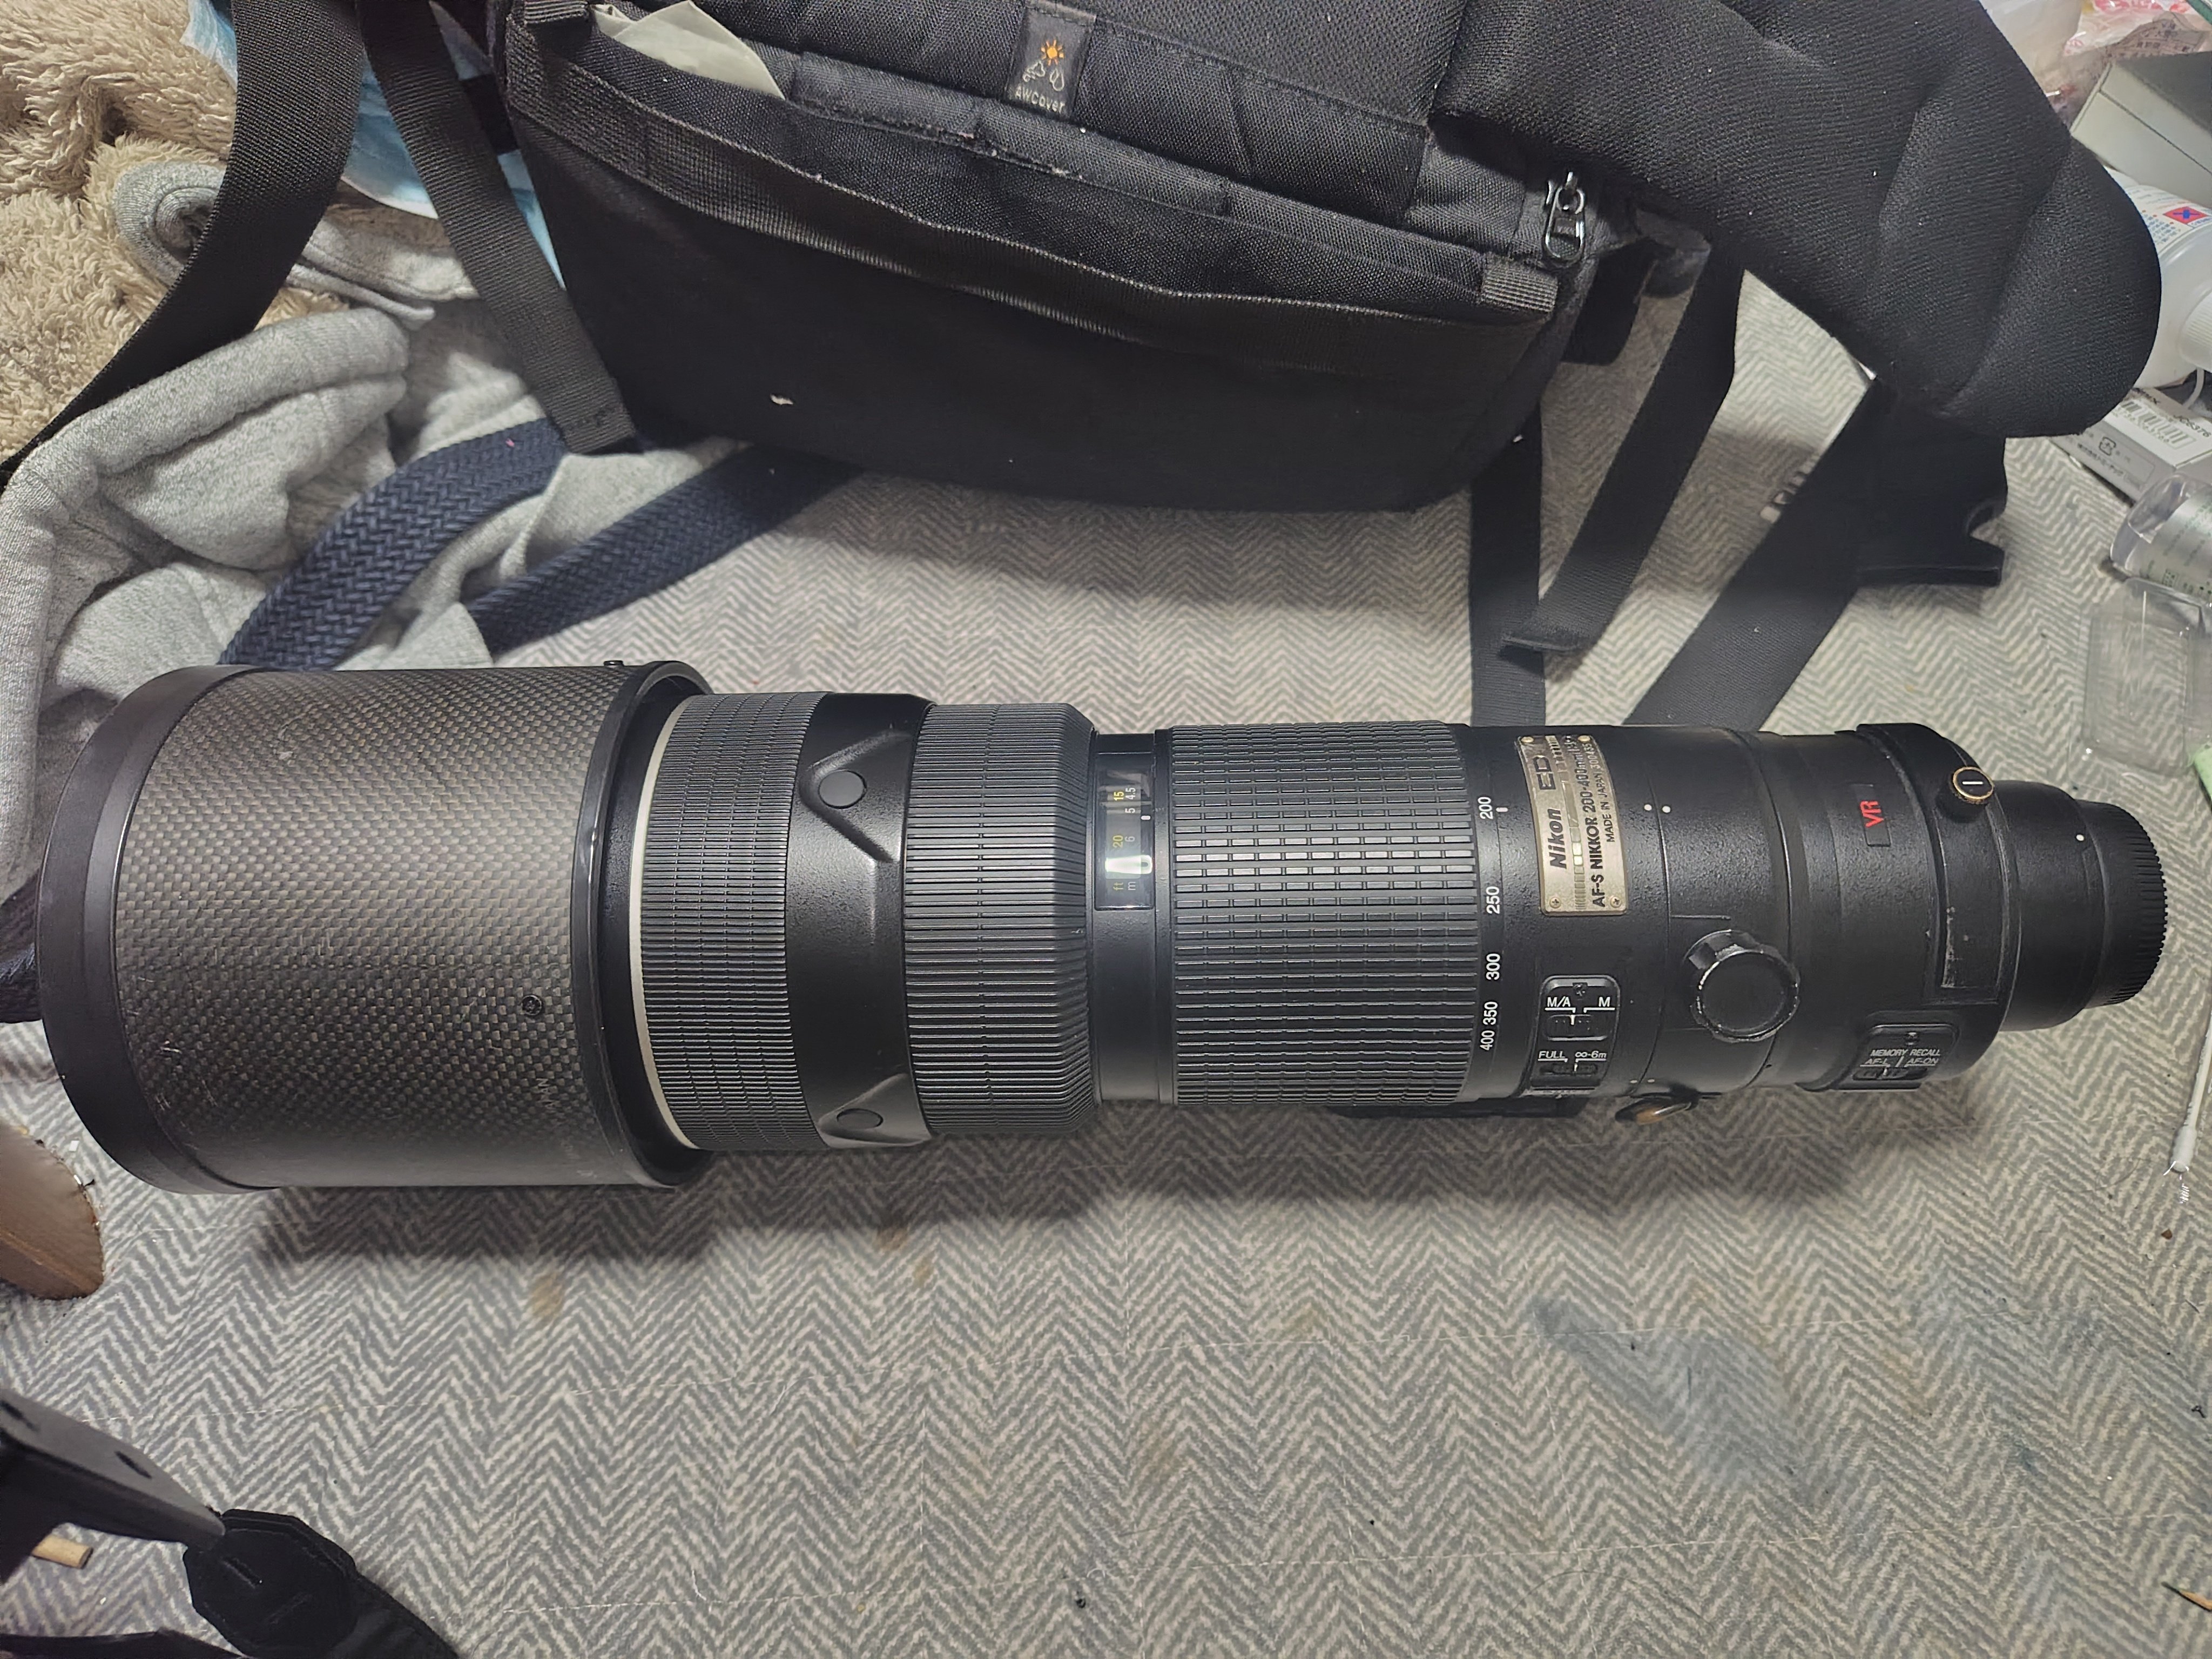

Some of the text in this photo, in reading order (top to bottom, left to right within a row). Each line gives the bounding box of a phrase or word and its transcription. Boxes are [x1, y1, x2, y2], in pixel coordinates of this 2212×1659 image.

[1533, 756, 1556, 790] ED
[1574, 753, 1596, 813] 200-400mm
[1114, 791, 1124, 801] 15
[1125, 787, 1136, 800] 4.5
[1594, 773, 1607, 798] JAPAN
[1478, 797, 1493, 819] 200
[1860, 801, 1884, 827] VR
[1547, 808, 1567, 869] Nikon
[1602, 814, 1615, 842] MADE
[1112, 835, 1123, 848] 20
[1585, 817, 1603, 869] NIKKOR
[1113, 882, 1124, 891] ft
[1128, 881, 1136, 891] m
[1591, 874, 1606, 907] AF-S
[1486, 886, 1500, 914] 250
[1486, 953, 1500, 980] 300
[1482, 1001, 1498, 1025] 350
[1547, 996, 1610, 1007] M/A M
[1480, 1030, 1495, 1050] 400
[1539, 1050, 1566, 1058] FULL
